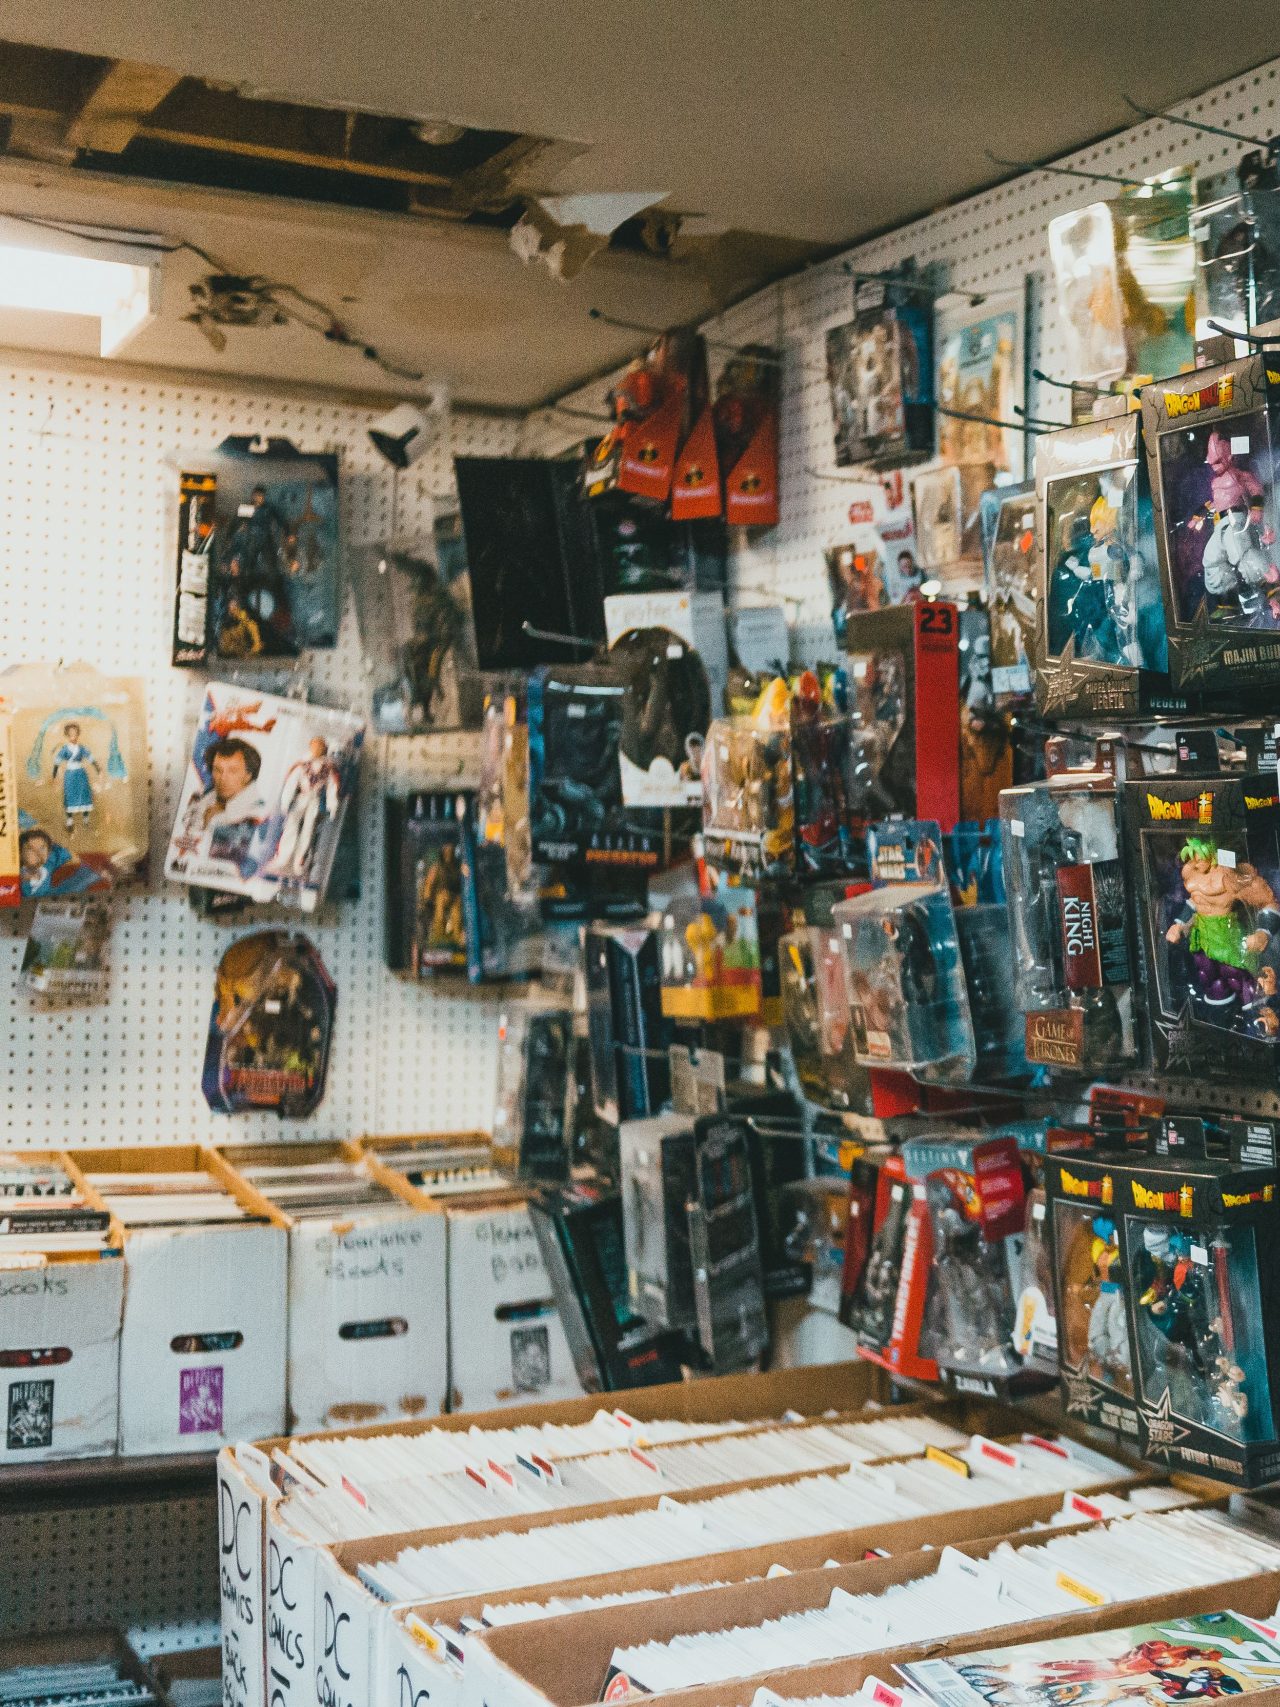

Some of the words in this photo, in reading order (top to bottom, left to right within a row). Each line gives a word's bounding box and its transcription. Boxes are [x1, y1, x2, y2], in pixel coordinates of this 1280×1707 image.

[919, 607, 952, 635] 23
[1223, 649, 1257, 667] MAJIN
[1147, 793, 1182, 820] DRAGON
[1063, 896, 1084, 957] KING
[1080, 901, 1095, 949] NIGHT
[1035, 1015, 1066, 1039] GAME
[1032, 1040, 1077, 1064] THRONES
[1148, 1429, 1174, 1443] STARS
[1180, 1447, 1210, 1466] FUTURE
[220, 1478, 251, 1582] DC
[269, 1537, 297, 1611] DC
[221, 1565, 254, 1625] COMICS
[268, 1604, 305, 1670] OMICS
[323, 1590, 351, 1681] DC
